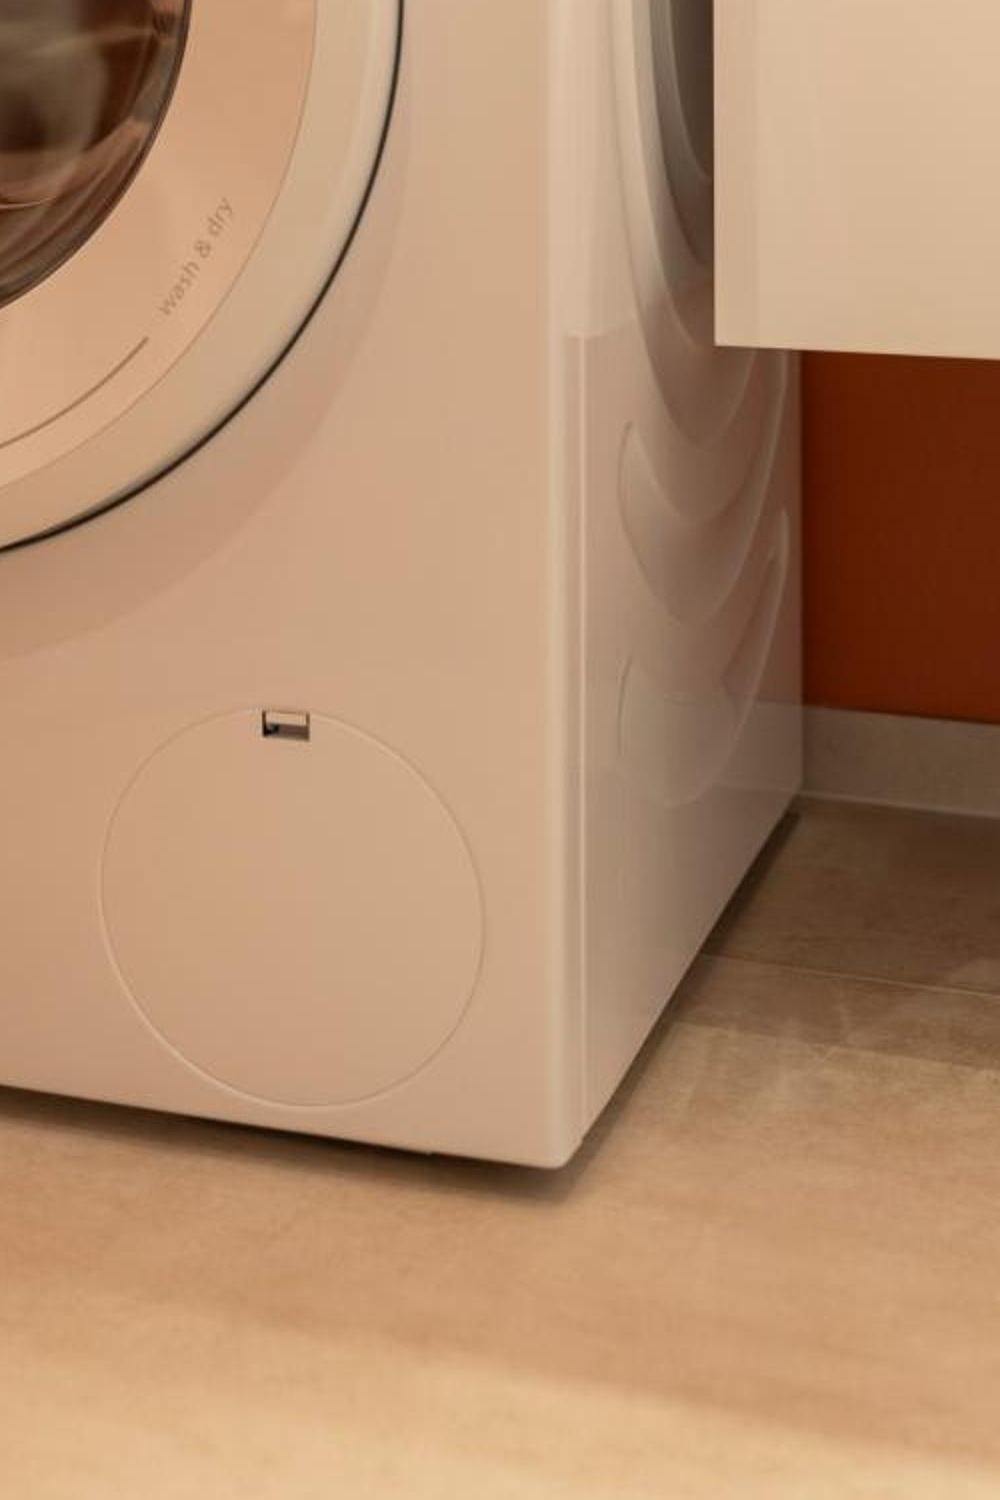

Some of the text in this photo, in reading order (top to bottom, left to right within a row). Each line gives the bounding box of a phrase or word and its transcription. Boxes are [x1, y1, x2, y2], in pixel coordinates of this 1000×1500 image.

[158, 197, 234, 316] wash & dry
